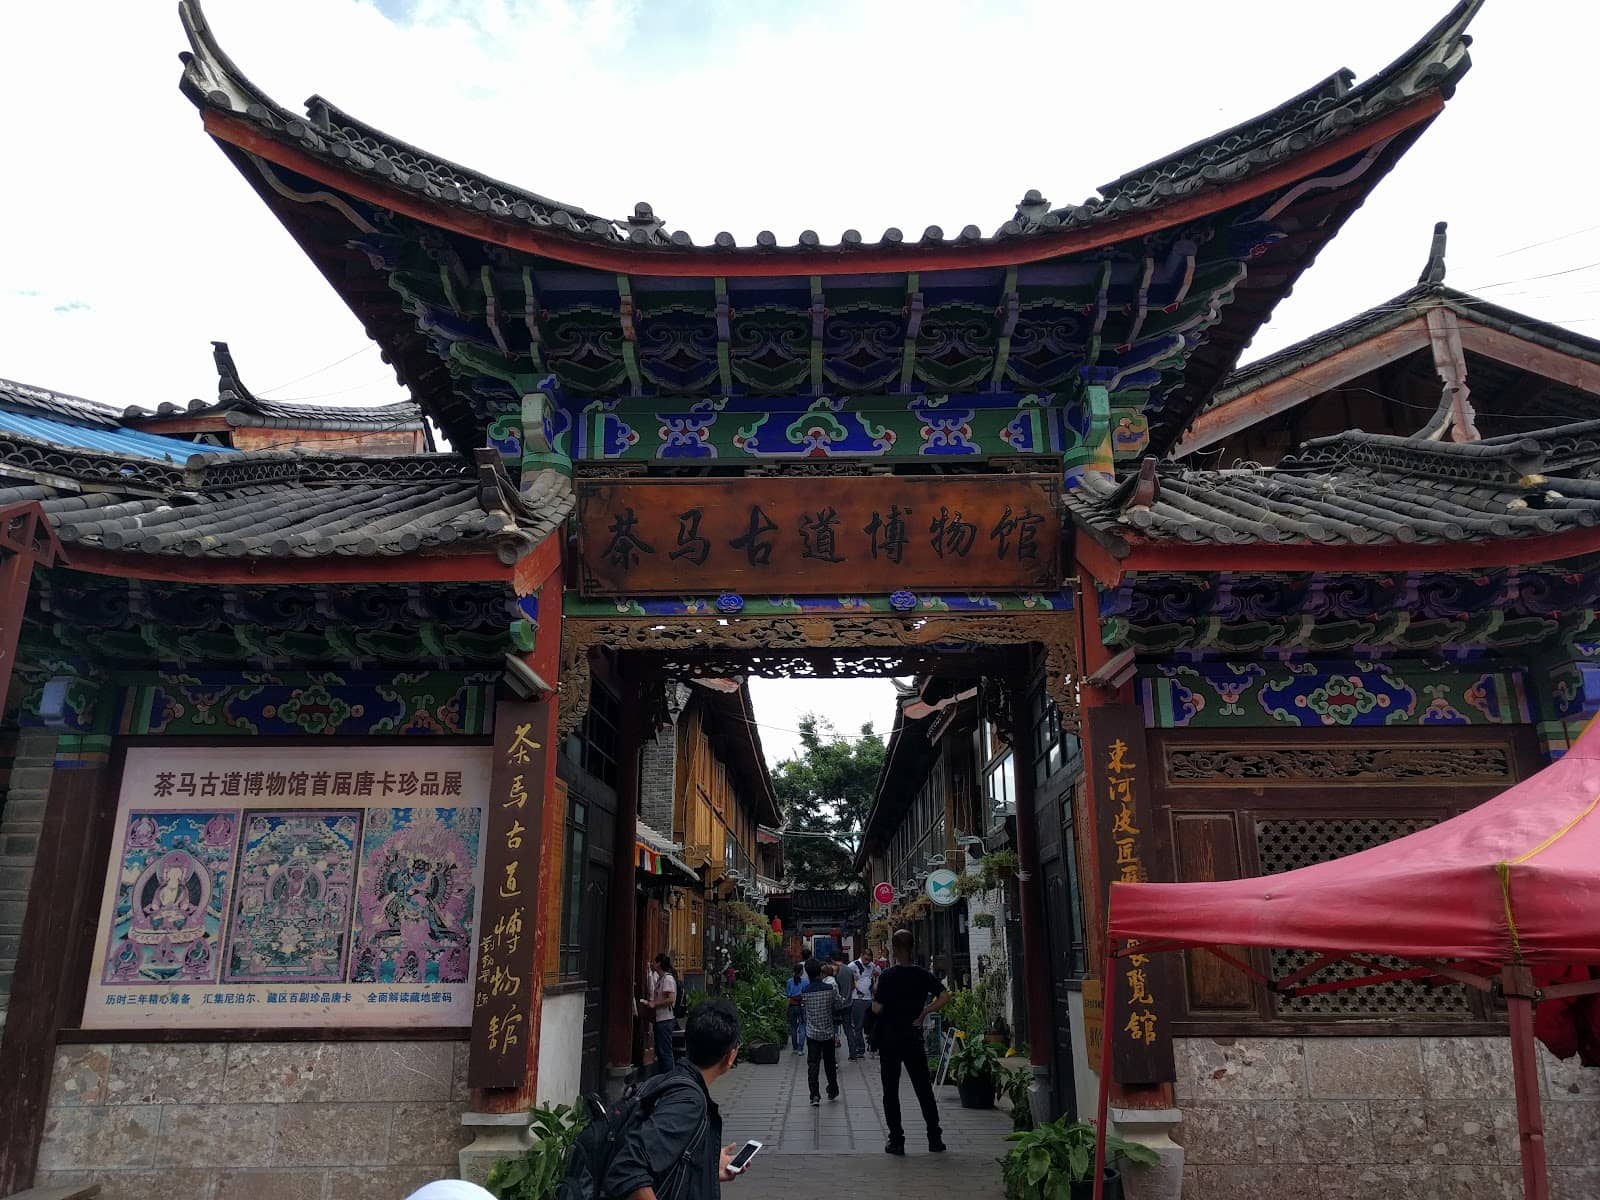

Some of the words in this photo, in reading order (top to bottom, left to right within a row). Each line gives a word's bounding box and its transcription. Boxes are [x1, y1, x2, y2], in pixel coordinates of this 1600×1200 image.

[603, 505, 1045, 570] 茶马古道博物馆
[153, 771, 462, 797] 茶马古道博物馆首届唐卡珍品展
[105, 993, 191, 1005] 历时三年精心筹备
[367, 991, 453, 1003] 全面解读藏地密码
